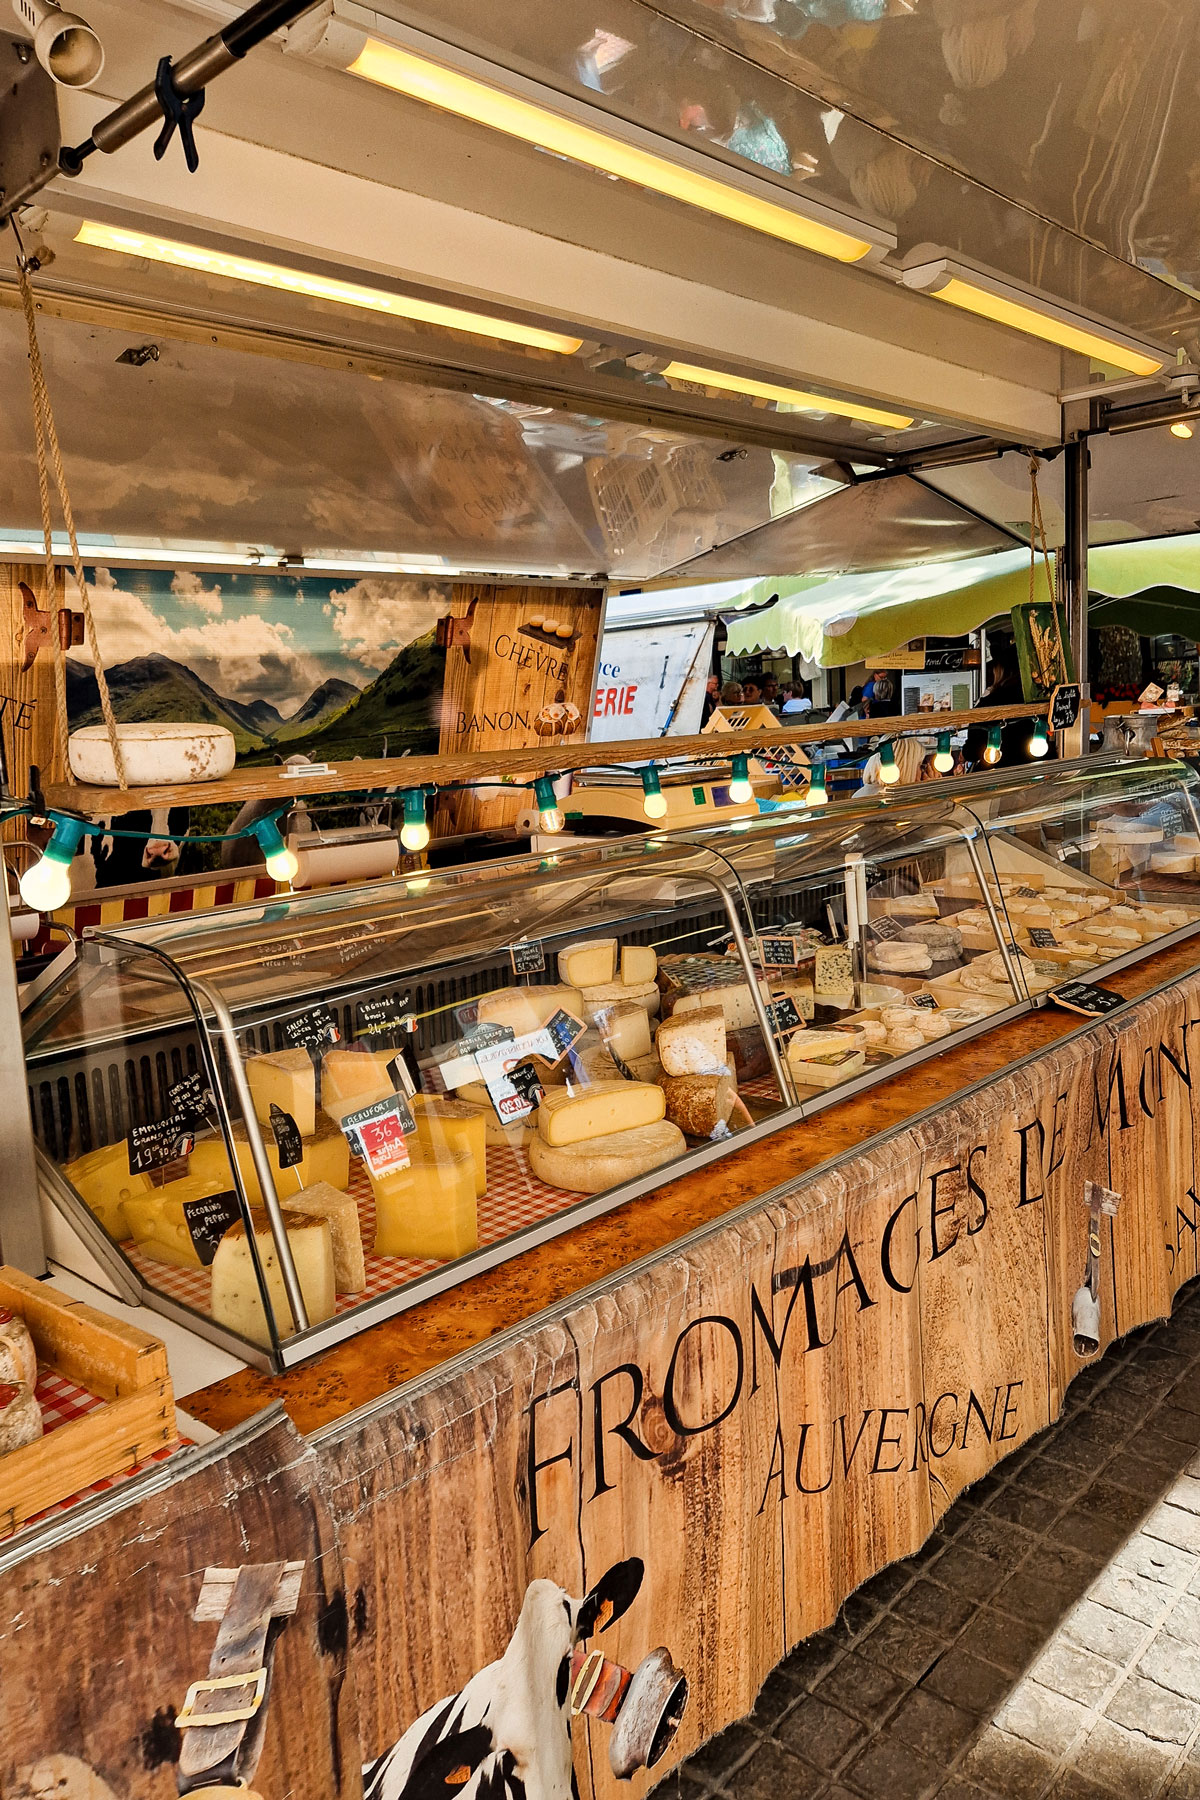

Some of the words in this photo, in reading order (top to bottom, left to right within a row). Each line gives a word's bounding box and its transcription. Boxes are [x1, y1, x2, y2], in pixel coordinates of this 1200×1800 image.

[494, 634, 569, 682] CHÈVRE
[593, 685, 638, 718] ERIE
[456, 710, 530, 734] BANON
[132, 1114, 186, 1137] EMMENTAL
[347, 1100, 389, 1126] BEAUFORT
[186, 1202, 222, 1219] PECORINO
[522, 1145, 988, 1555] FROMAGES
[1013, 1092, 1067, 1208] DE
[755, 1380, 1023, 1517] AUVERGNE
